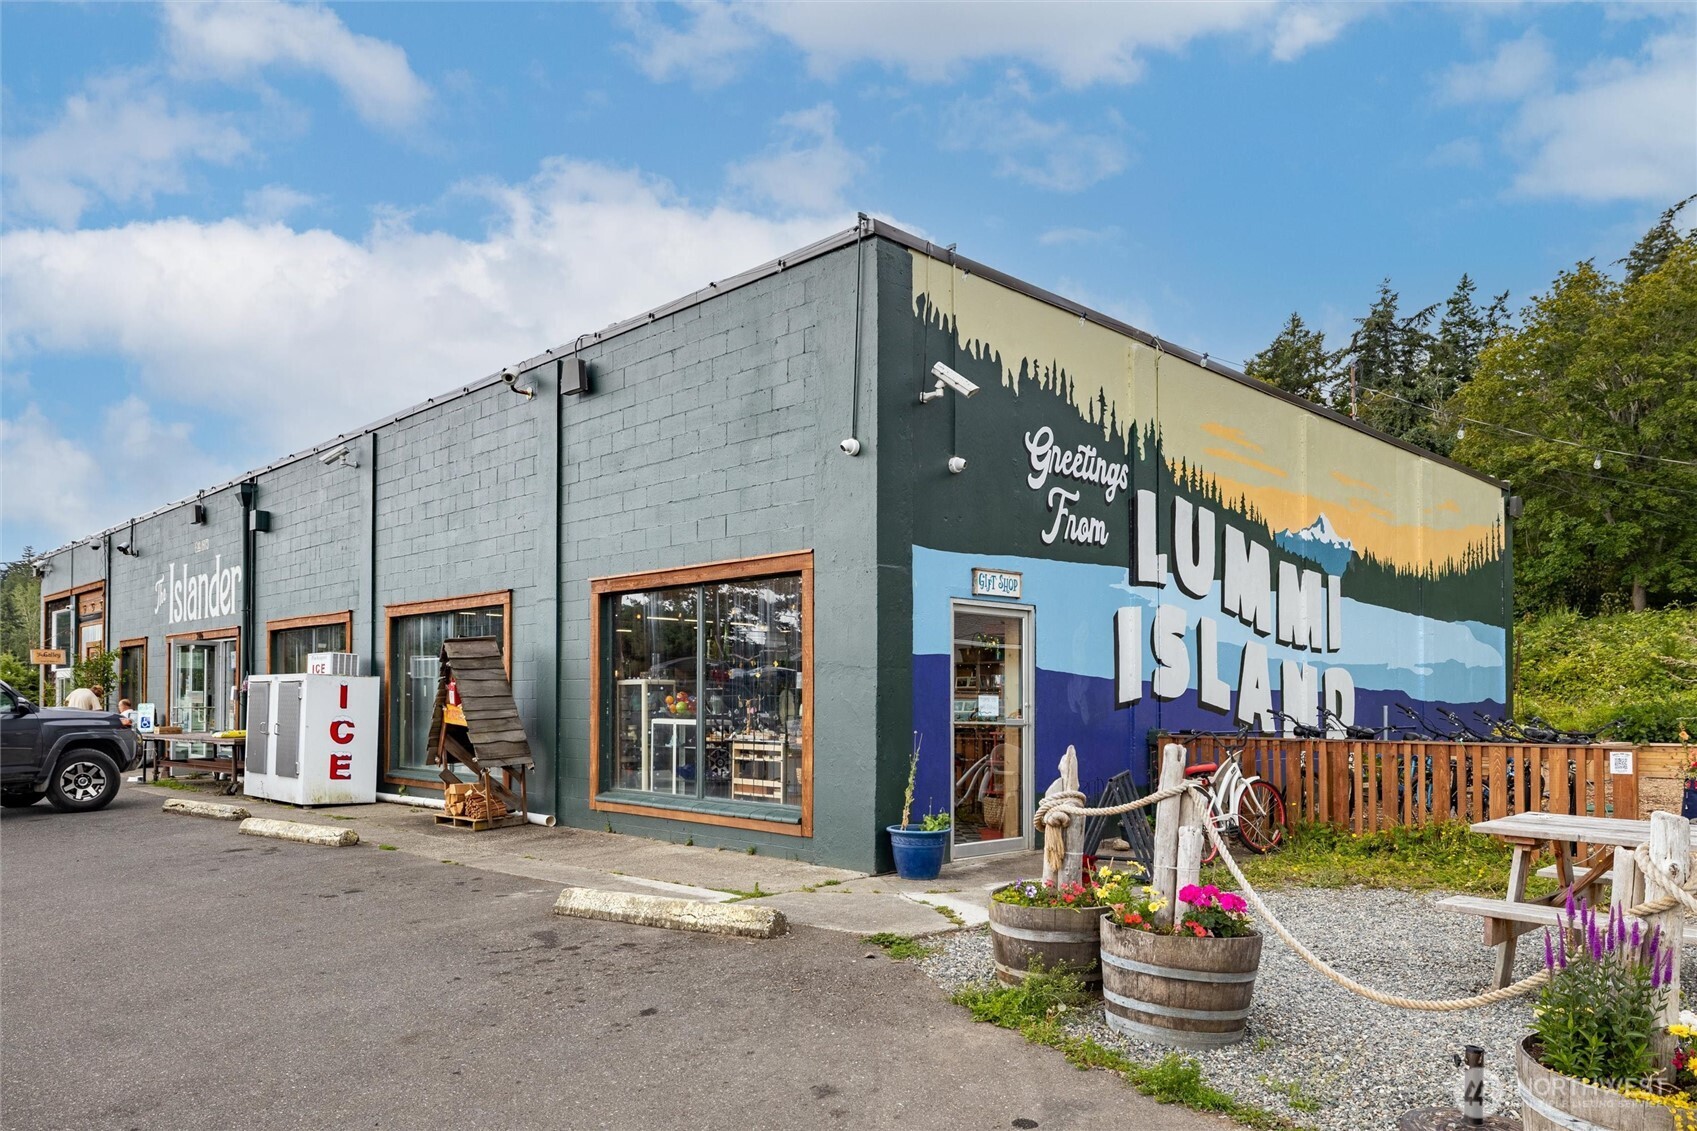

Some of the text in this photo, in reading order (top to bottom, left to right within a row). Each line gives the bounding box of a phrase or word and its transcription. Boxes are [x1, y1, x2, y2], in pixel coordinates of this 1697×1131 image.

[1025, 426, 1129, 503] Greetings
[1041, 486, 1110, 544] From
[154, 554, 242, 624] The Islander
[978, 572, 1019, 594] GIFT SHOP
[1131, 489, 1341, 653] LUMMI
[312, 663, 326, 674] ICE
[1115, 604, 1356, 739] ISLAND
[329, 680, 355, 780] ICE
